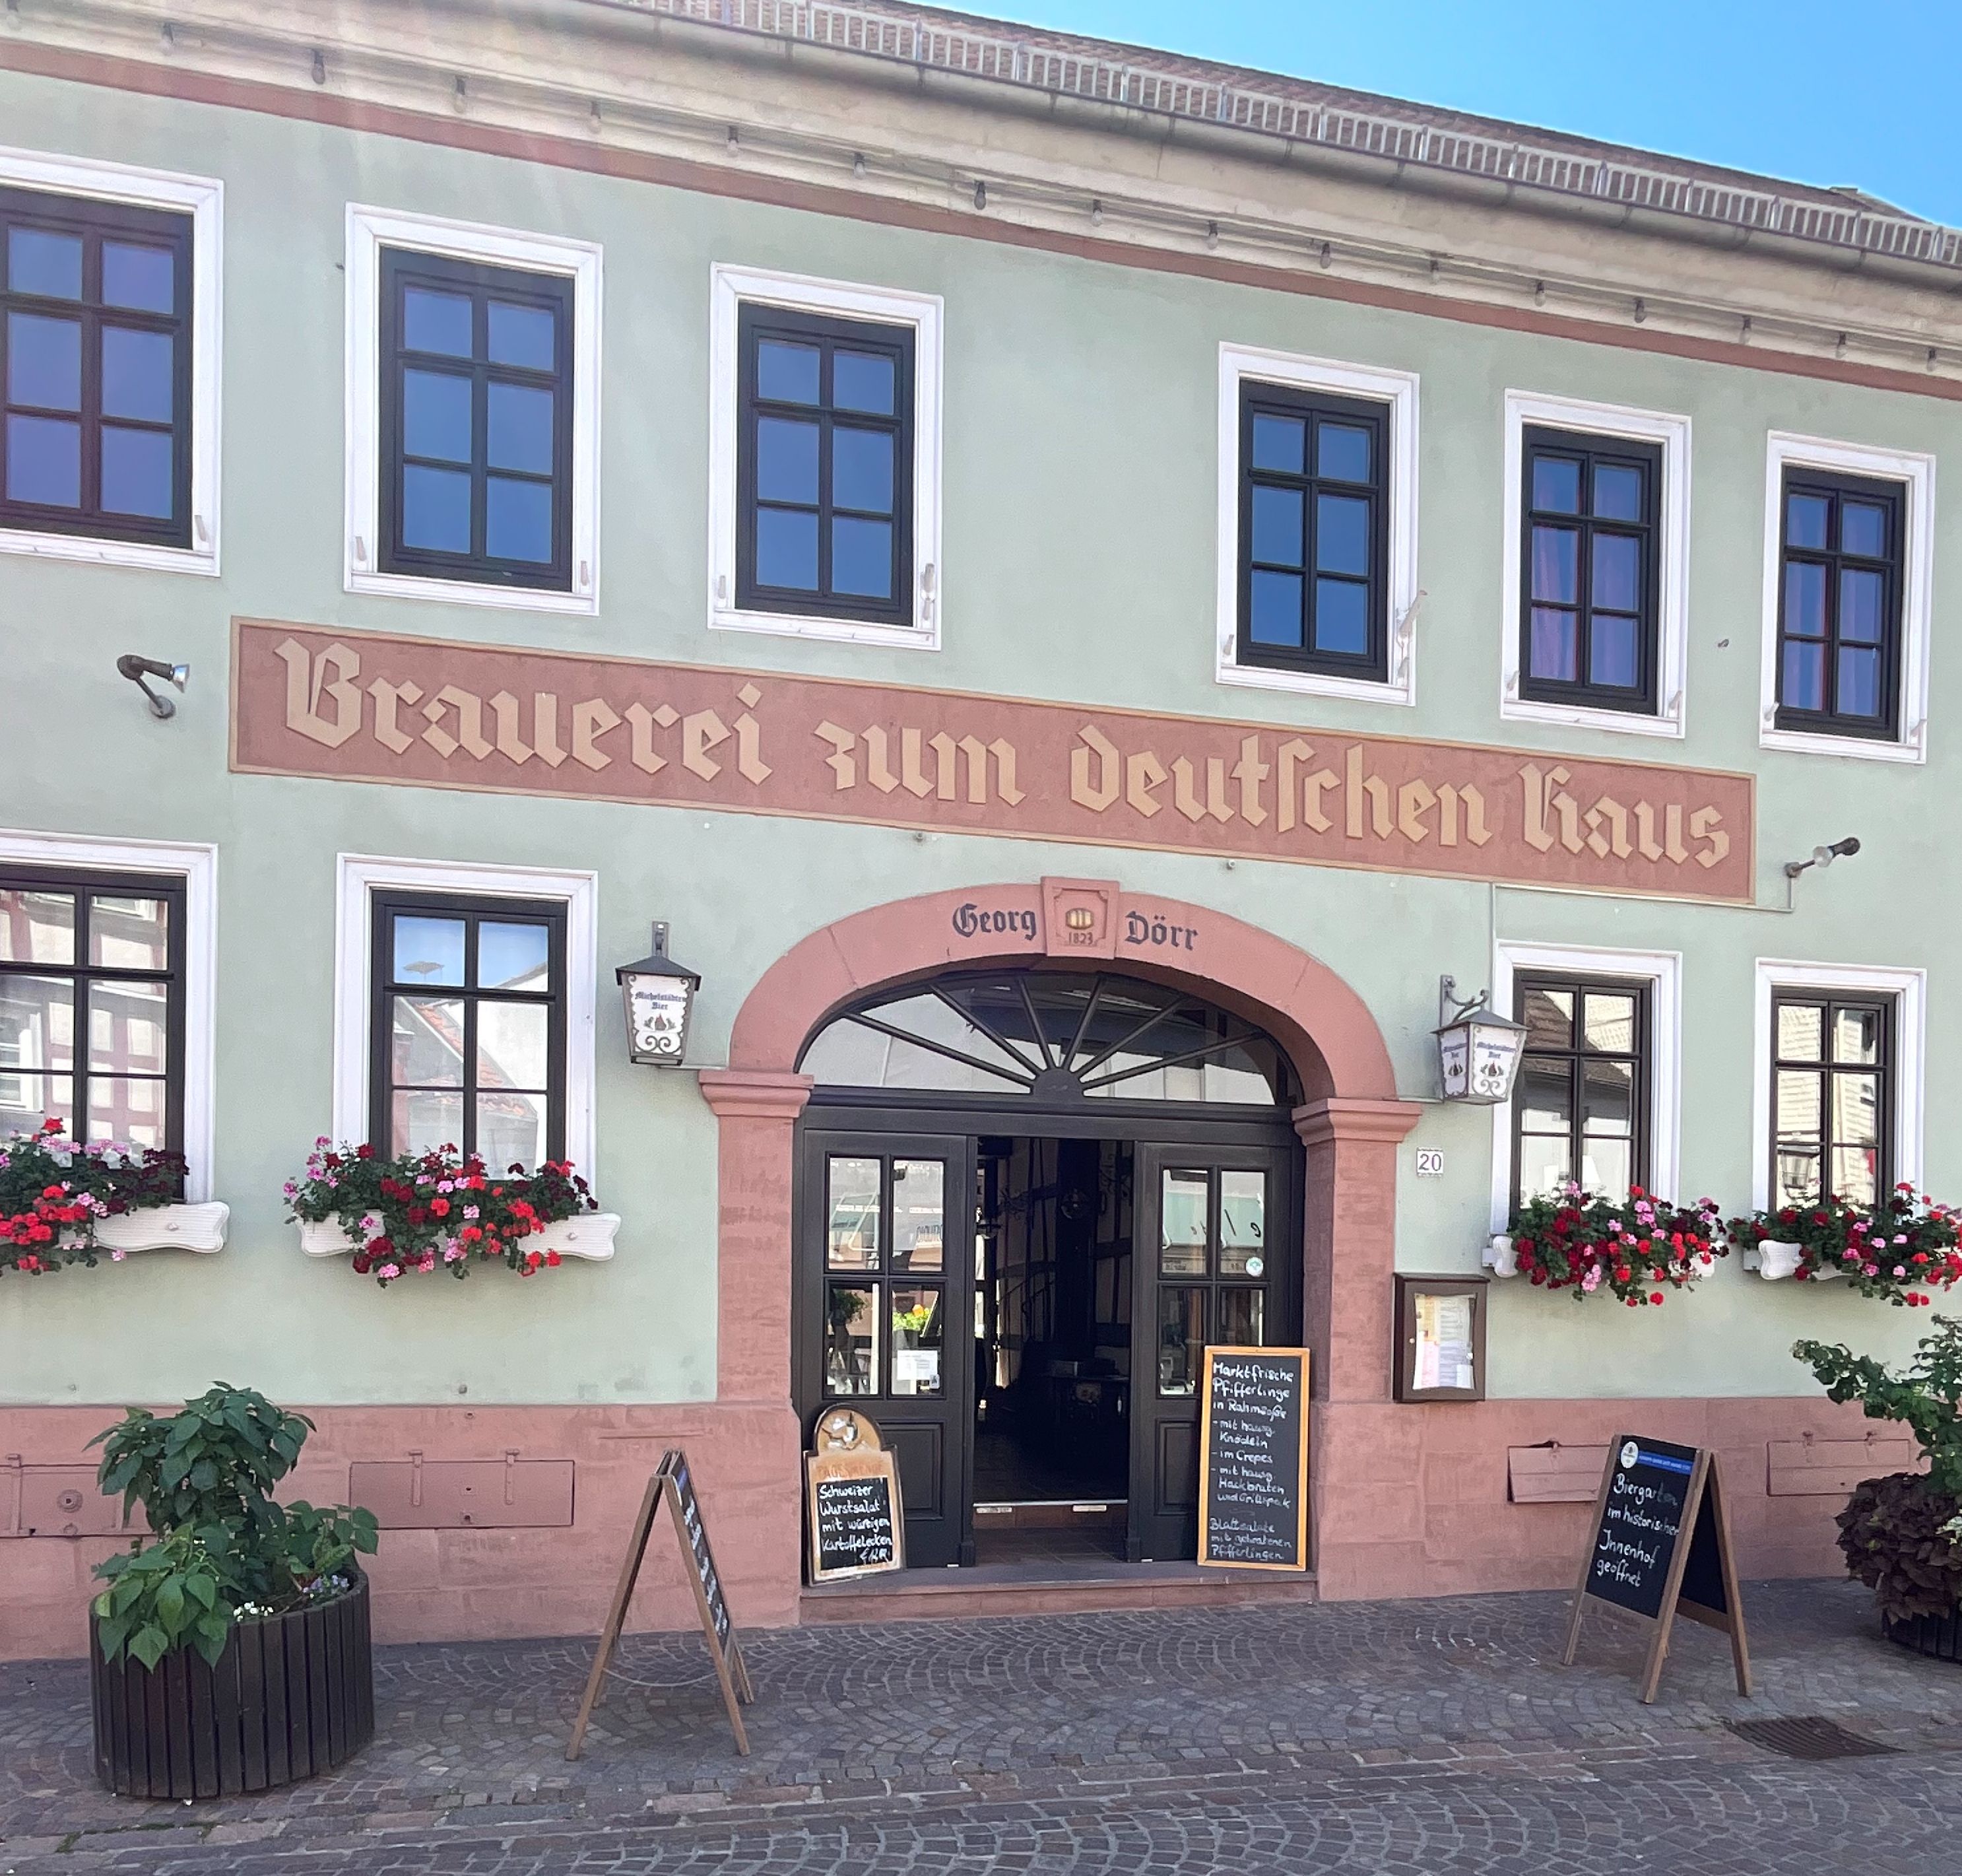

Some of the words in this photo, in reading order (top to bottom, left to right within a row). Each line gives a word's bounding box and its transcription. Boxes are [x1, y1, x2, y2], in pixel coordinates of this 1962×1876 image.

[273, 636, 773, 786] Brauerei
[812, 719, 1027, 807] zum
[1517, 762, 1731, 869] Haus
[952, 903, 1037, 941] Georg
[1125, 910, 1199, 952] Dörr
[1068, 931, 1095, 946] 1823
[1418, 1153, 1442, 1172] 20
[1212, 1362, 1294, 1383] Marktfrische
[1212, 1376, 1290, 1403] Pfifferlinge
[1213, 1401, 1224, 1410] in
[1220, 1419, 1237, 1430] mit
[1219, 1430, 1268, 1449] Knödeln
[1219, 1465, 1238, 1475] mit
[820, 1485, 873, 1500] Schweizer
[820, 1498, 881, 1516] Wurstsalat
[822, 1516, 844, 1533] mit
